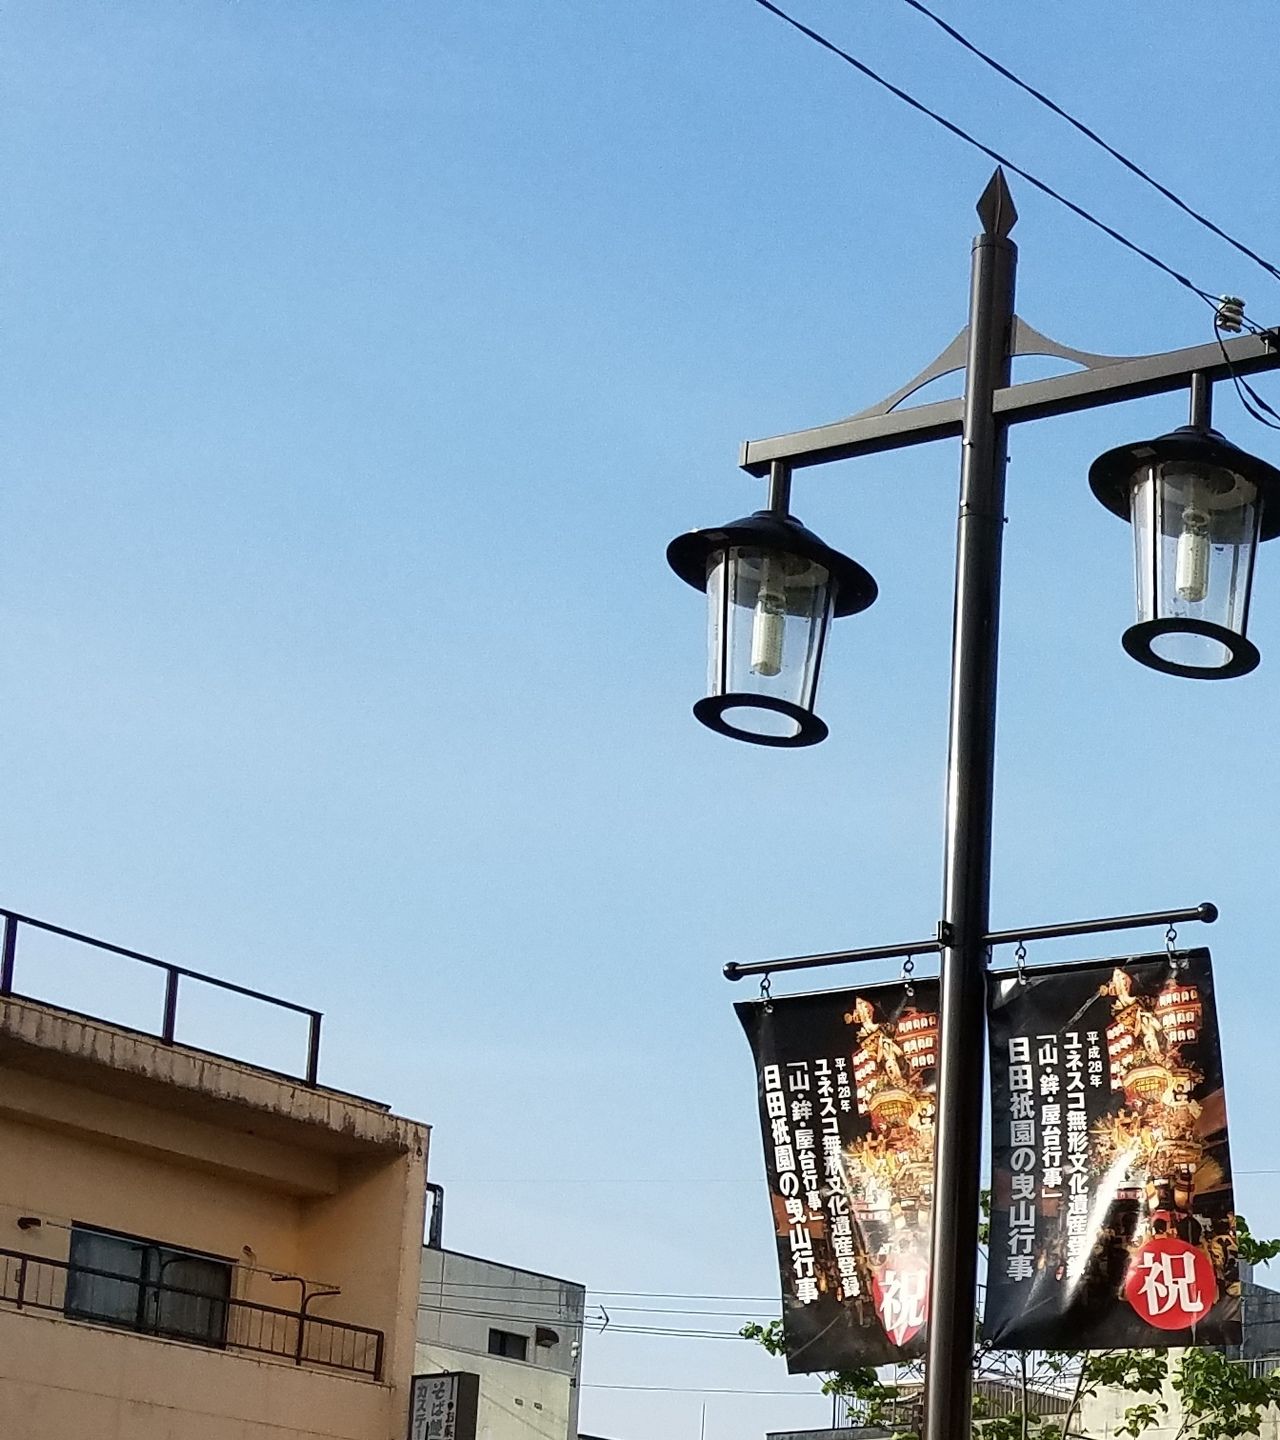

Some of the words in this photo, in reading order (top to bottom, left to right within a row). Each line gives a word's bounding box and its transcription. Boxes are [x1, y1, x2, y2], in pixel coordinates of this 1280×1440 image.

[834, 1057, 851, 1113] 平成28年
[1086, 1031, 1103, 1088] 平成28年
[764, 1064, 818, 1304] 日田祇園の曳山行事
[814, 1058, 860, 1298] ユネスコ無形文化遺産登録
[1006, 1036, 1036, 1281] 日田祇園の曳山行事
[879, 1269, 928, 1330] 祝
[1137, 1250, 1204, 1316] 祝
